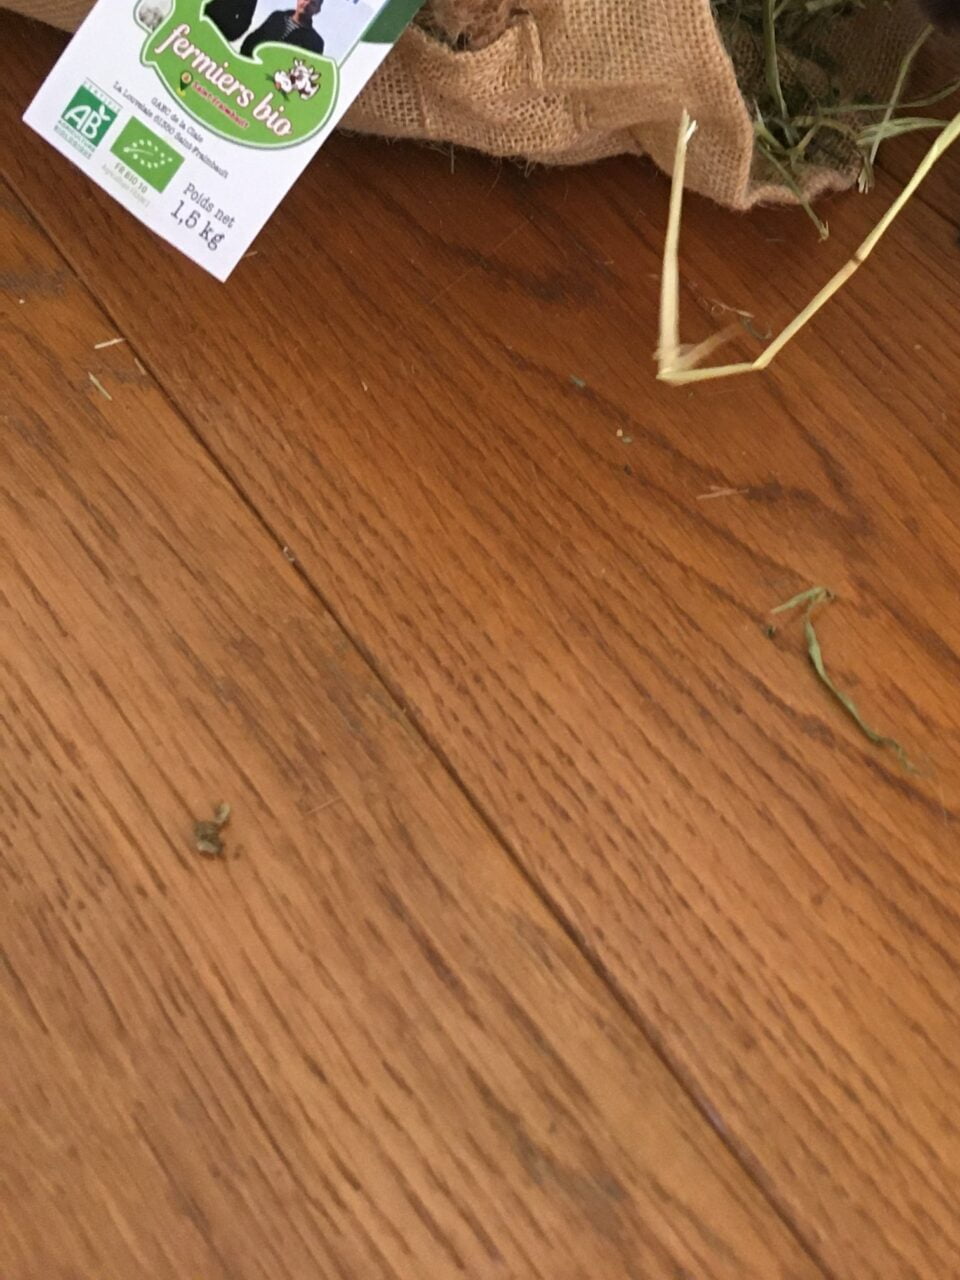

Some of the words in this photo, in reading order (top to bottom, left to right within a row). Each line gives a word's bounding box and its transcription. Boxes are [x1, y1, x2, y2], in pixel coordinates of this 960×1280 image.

[154, 22, 256, 108] fermiers
[251, 92, 292, 135] bio
[63, 105, 101, 139] AB
[169, 112, 180, 124] de
[170, 198, 202, 230] 1,5
[198, 220, 224, 249] kg
[182, 182, 216, 213] Poids
[213, 209, 236, 229] net
